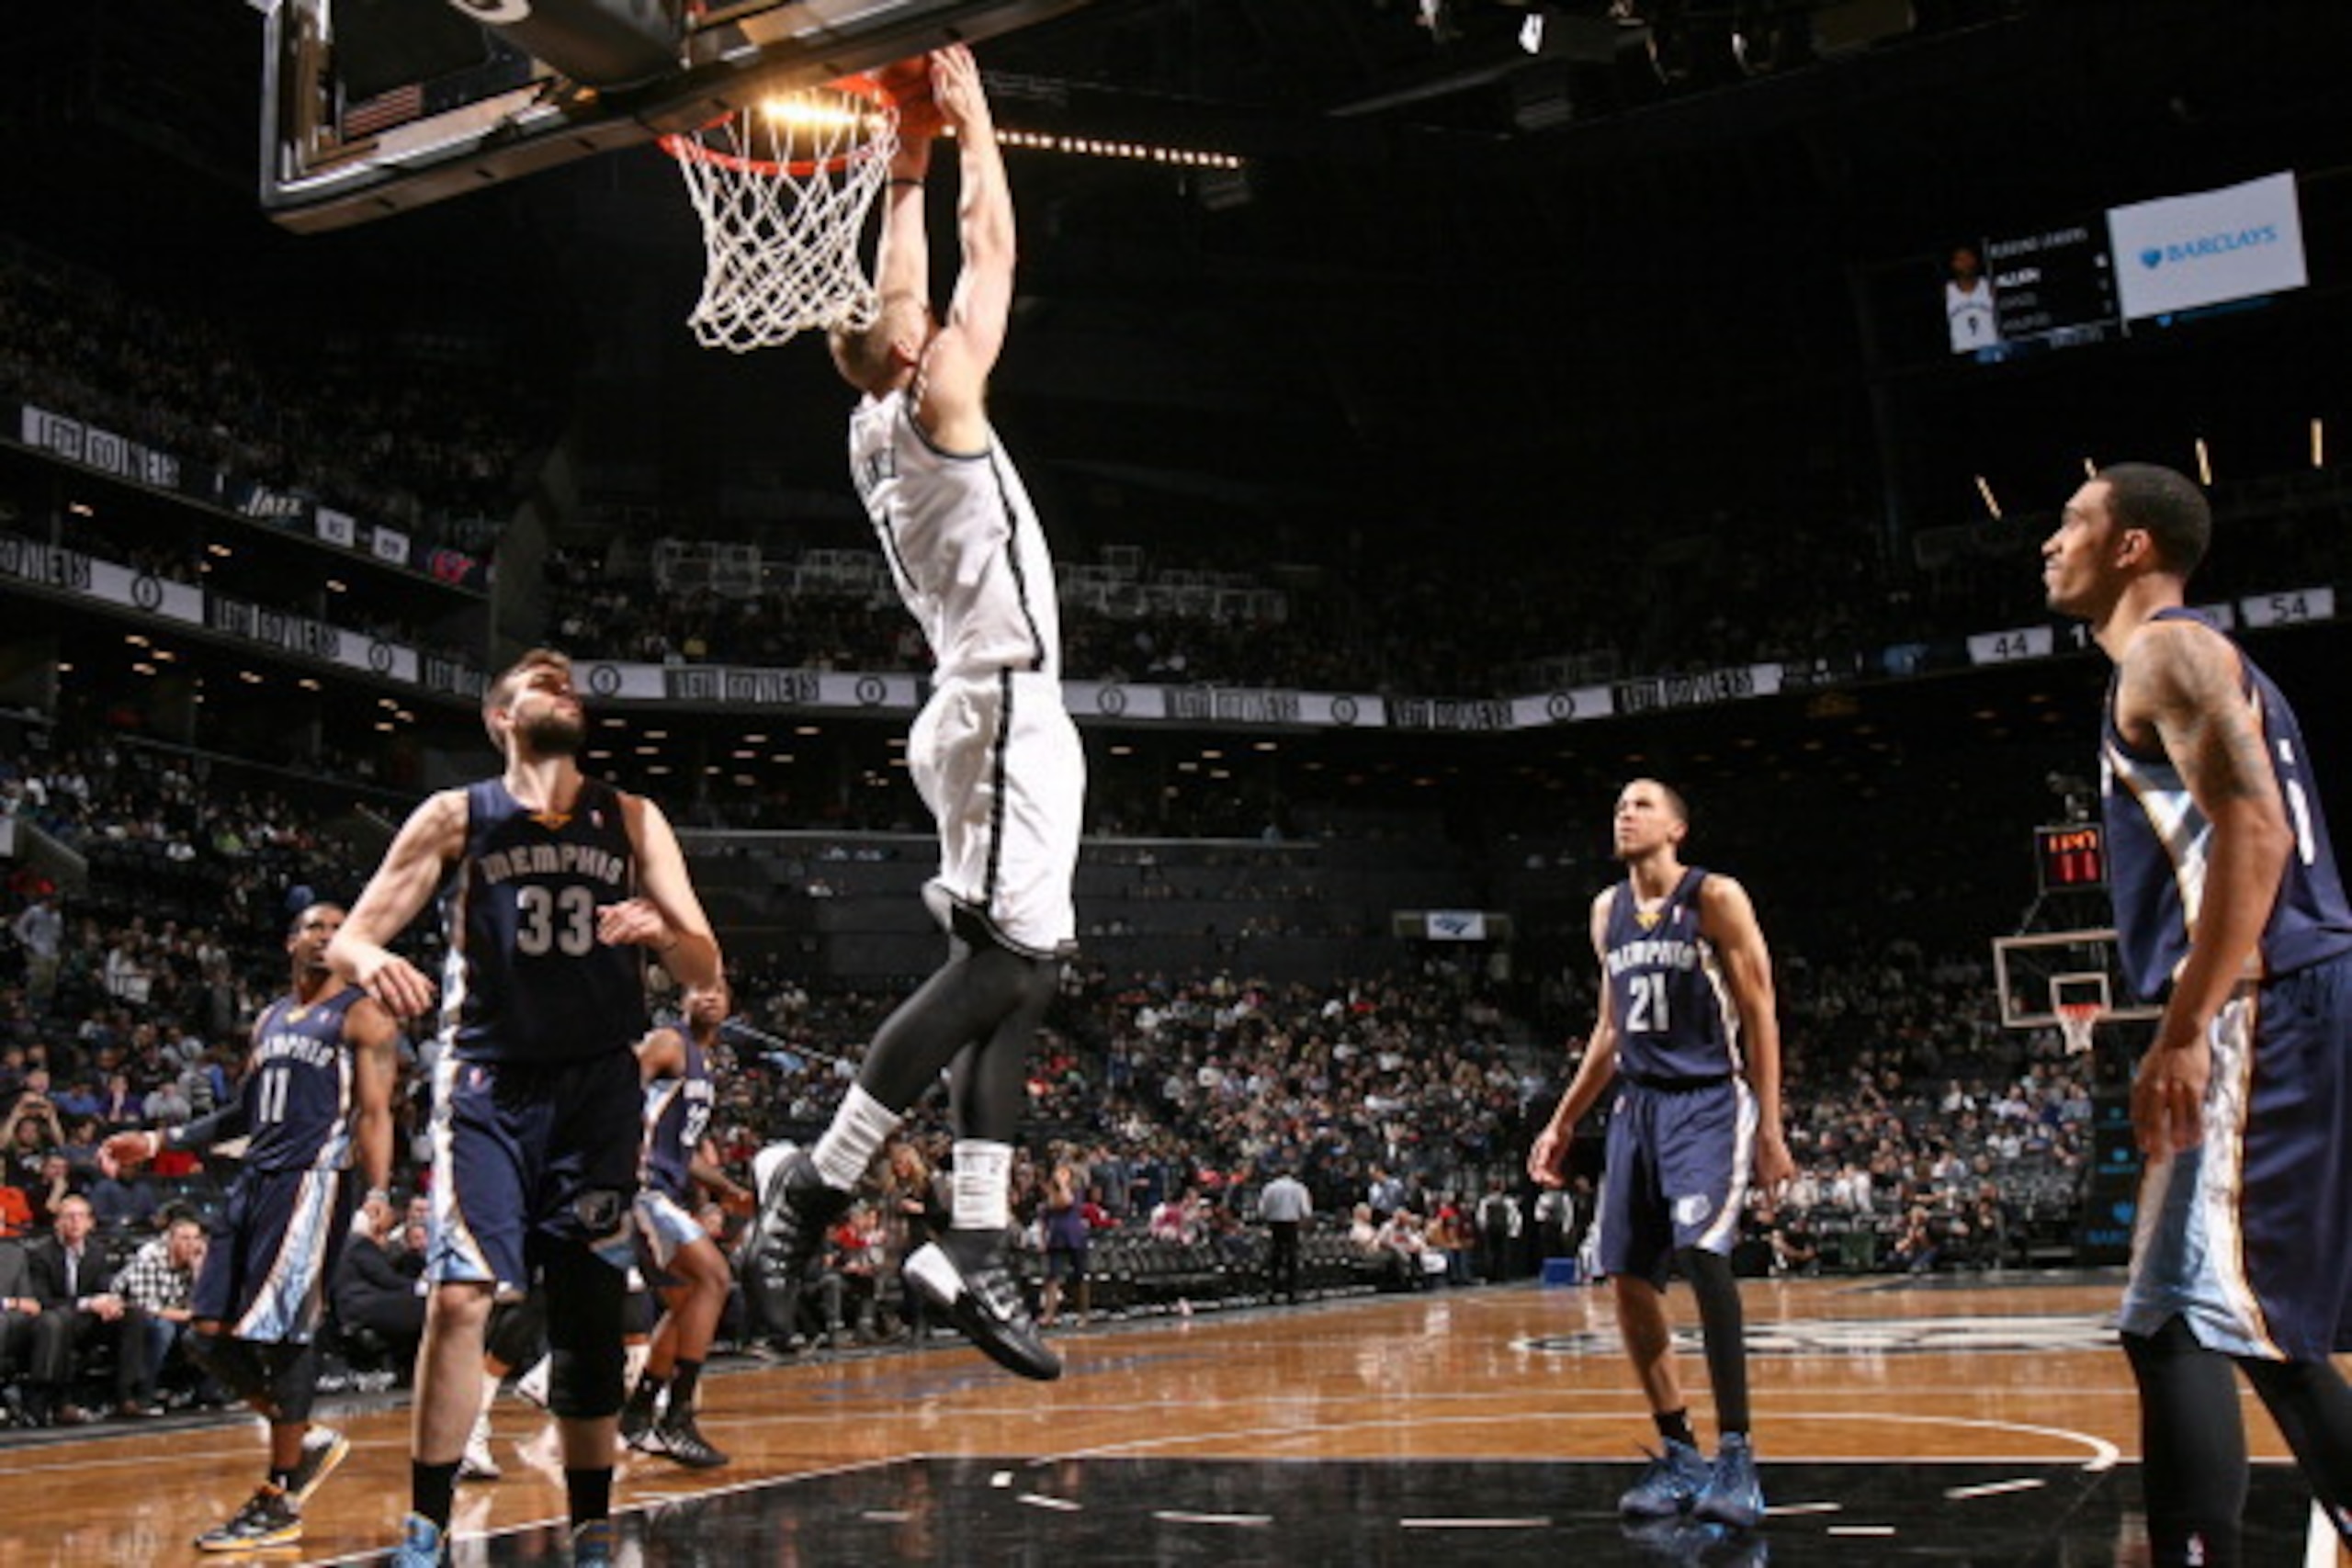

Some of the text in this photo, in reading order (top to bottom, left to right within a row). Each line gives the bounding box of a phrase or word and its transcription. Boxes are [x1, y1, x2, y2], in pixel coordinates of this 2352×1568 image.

[2167, 226, 2278, 263] BARCLAYS
[2270, 596, 2308, 624] 54
[1995, 634, 2028, 659] 44
[481, 843, 624, 886] MEMPHIS
[516, 884, 593, 957] 33
[1625, 972, 1670, 1032] 21
[259, 1066, 291, 1122] 11
